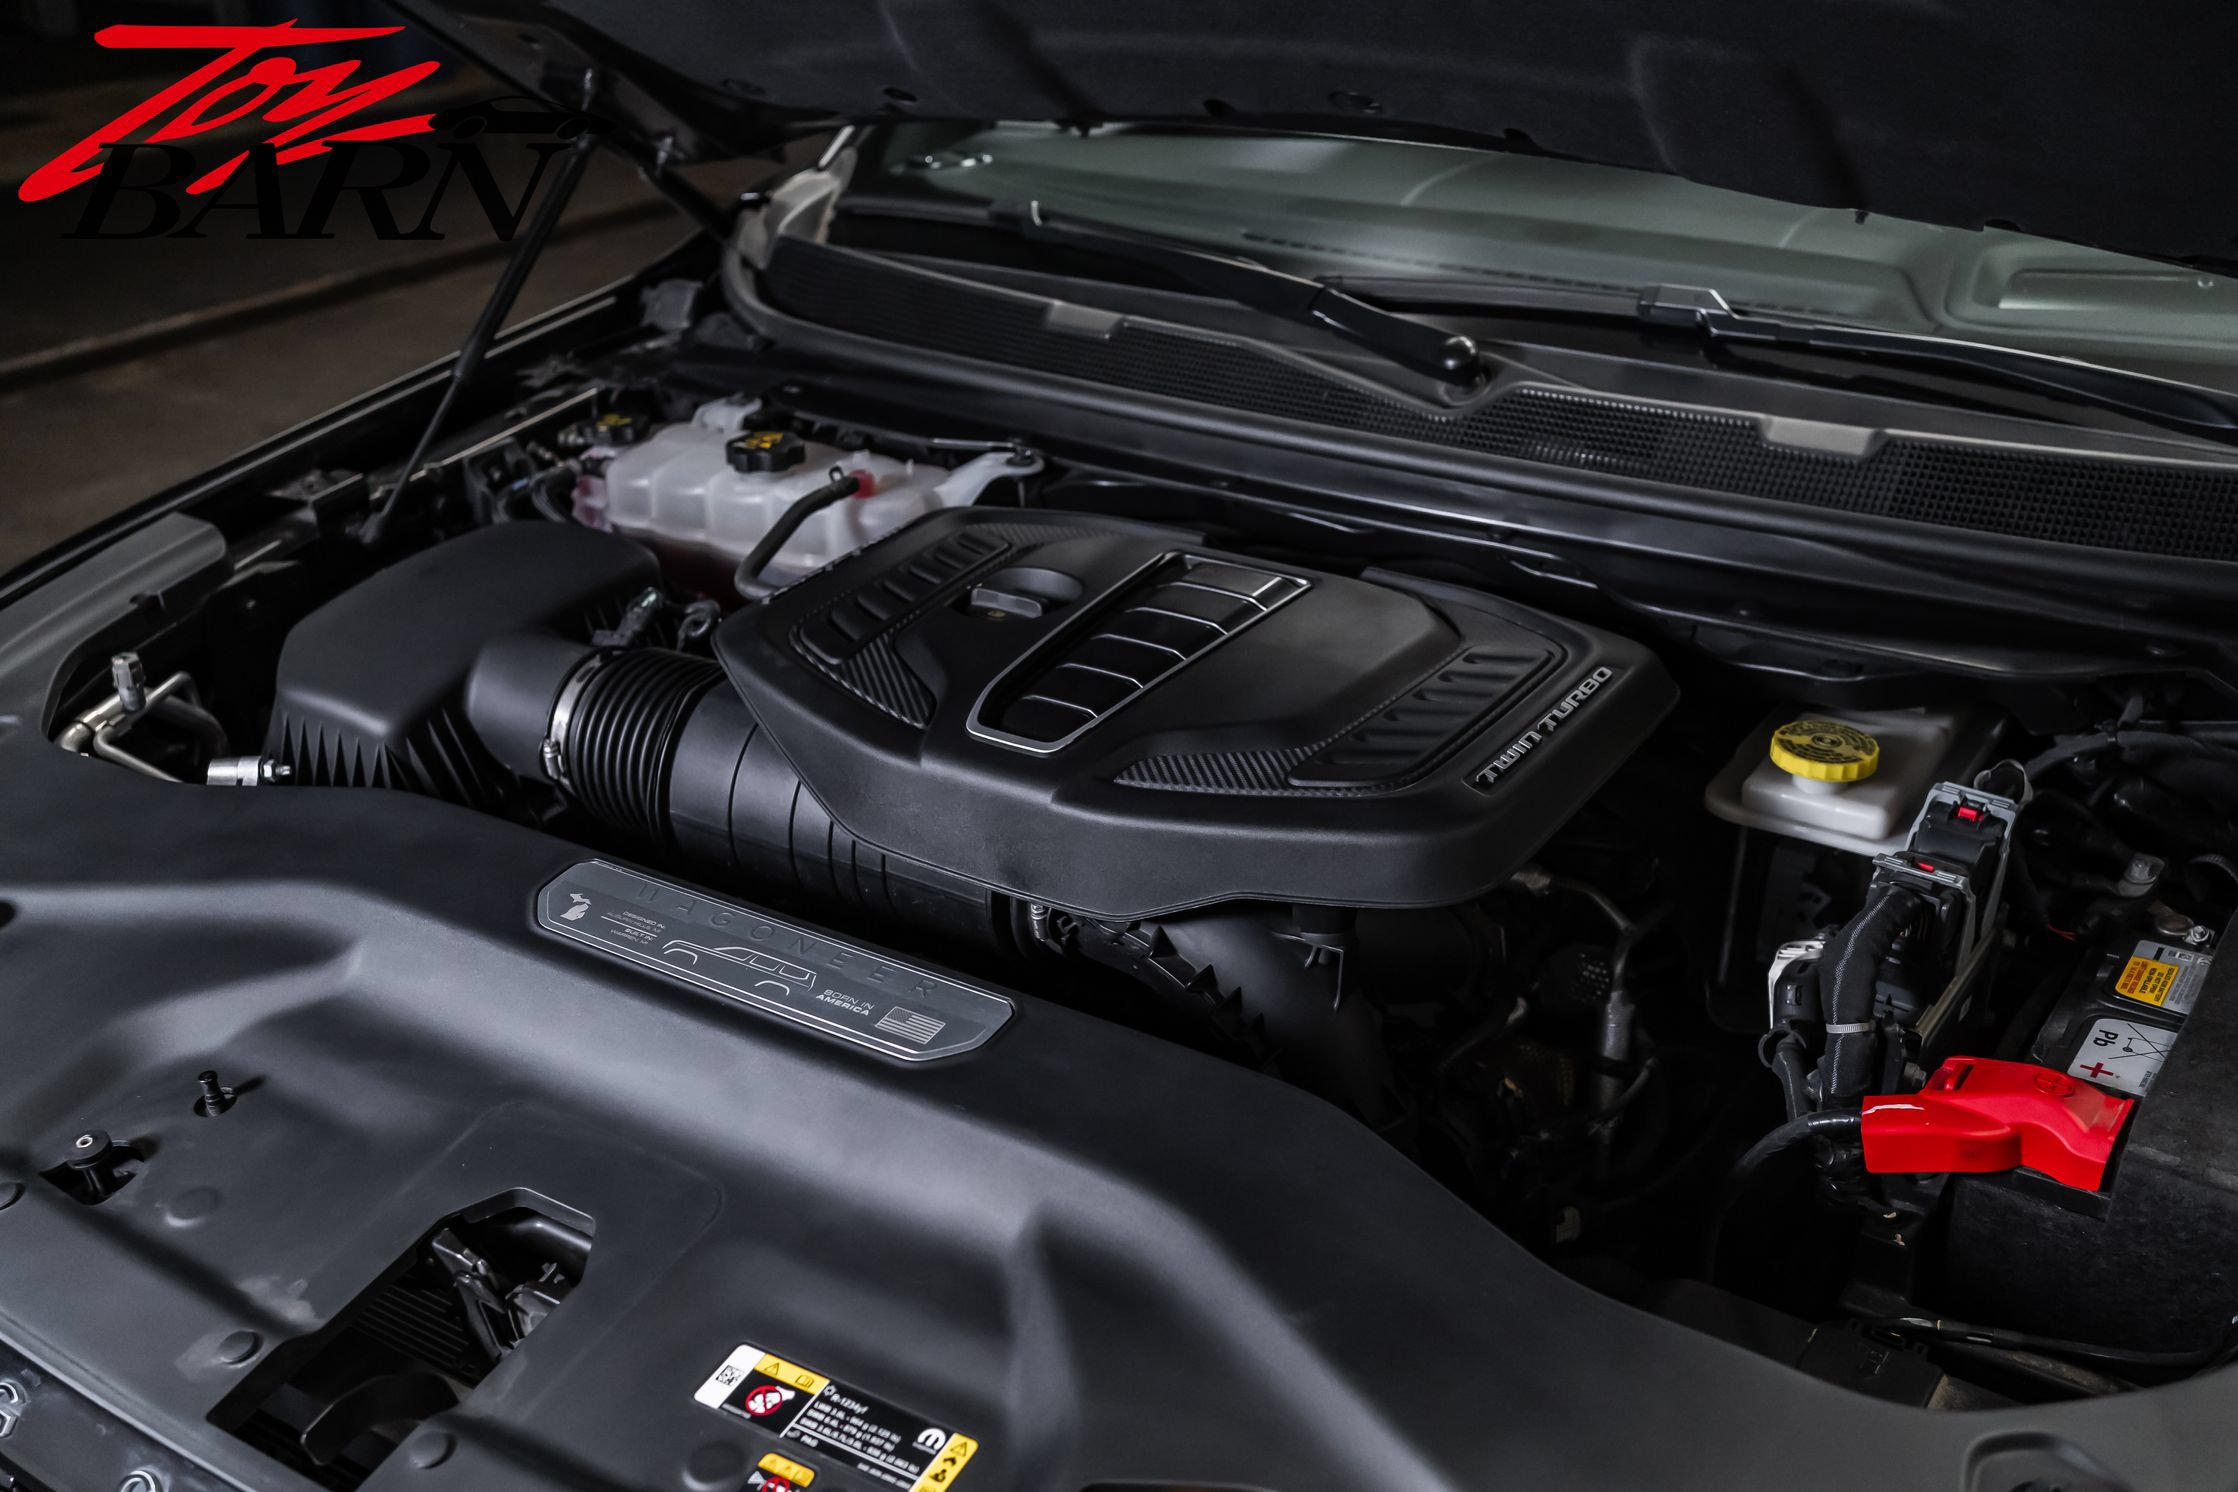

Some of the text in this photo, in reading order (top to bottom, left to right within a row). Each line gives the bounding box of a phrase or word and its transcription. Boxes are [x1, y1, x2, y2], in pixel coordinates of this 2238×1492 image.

[1476, 666, 1614, 784] TWIN TURBO
[635, 884, 939, 999] WAGONEER
[815, 994, 870, 1016] AMERICA
[823, 989, 875, 1010] BORN IN
[2093, 1029, 2119, 1048] Pb
